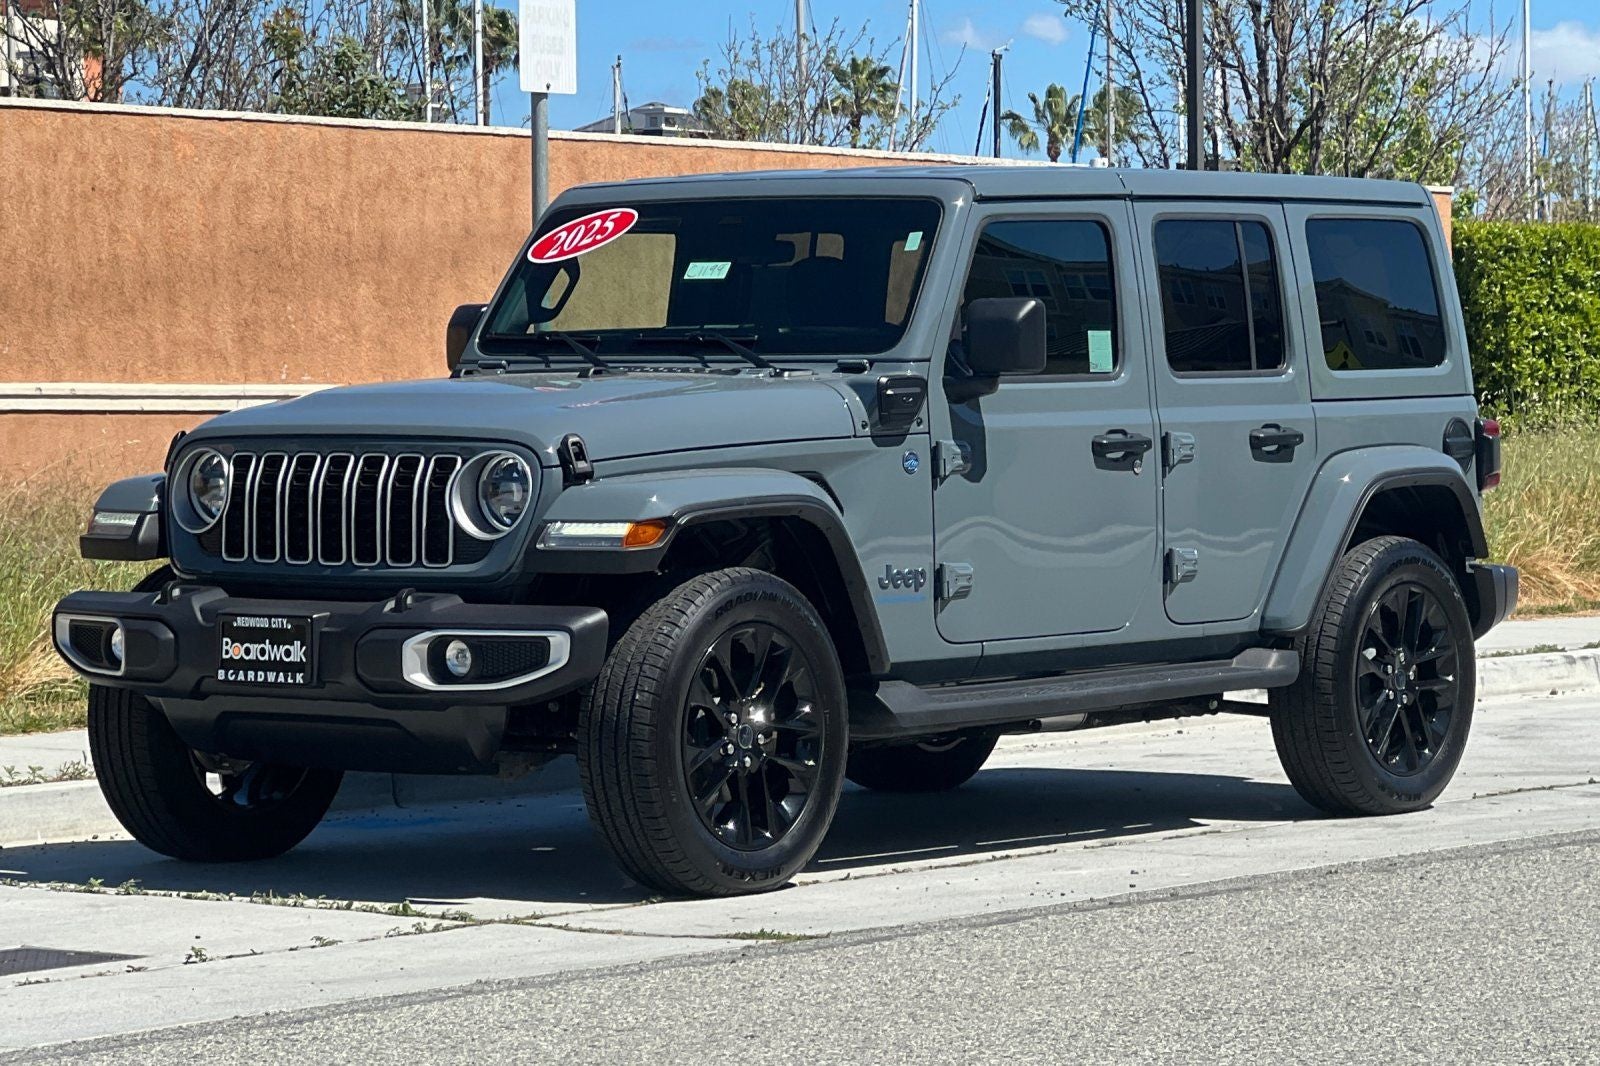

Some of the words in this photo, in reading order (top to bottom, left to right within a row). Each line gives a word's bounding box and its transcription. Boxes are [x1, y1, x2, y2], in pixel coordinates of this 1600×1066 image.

[543, 212, 622, 259] 2025
[878, 564, 927, 593] Jeep
[236, 616, 269, 628] REDWOOD
[271, 618, 287, 629] CITY
[222, 637, 306, 663] Boardwalk
[217, 669, 304, 684] BOARDWALK
